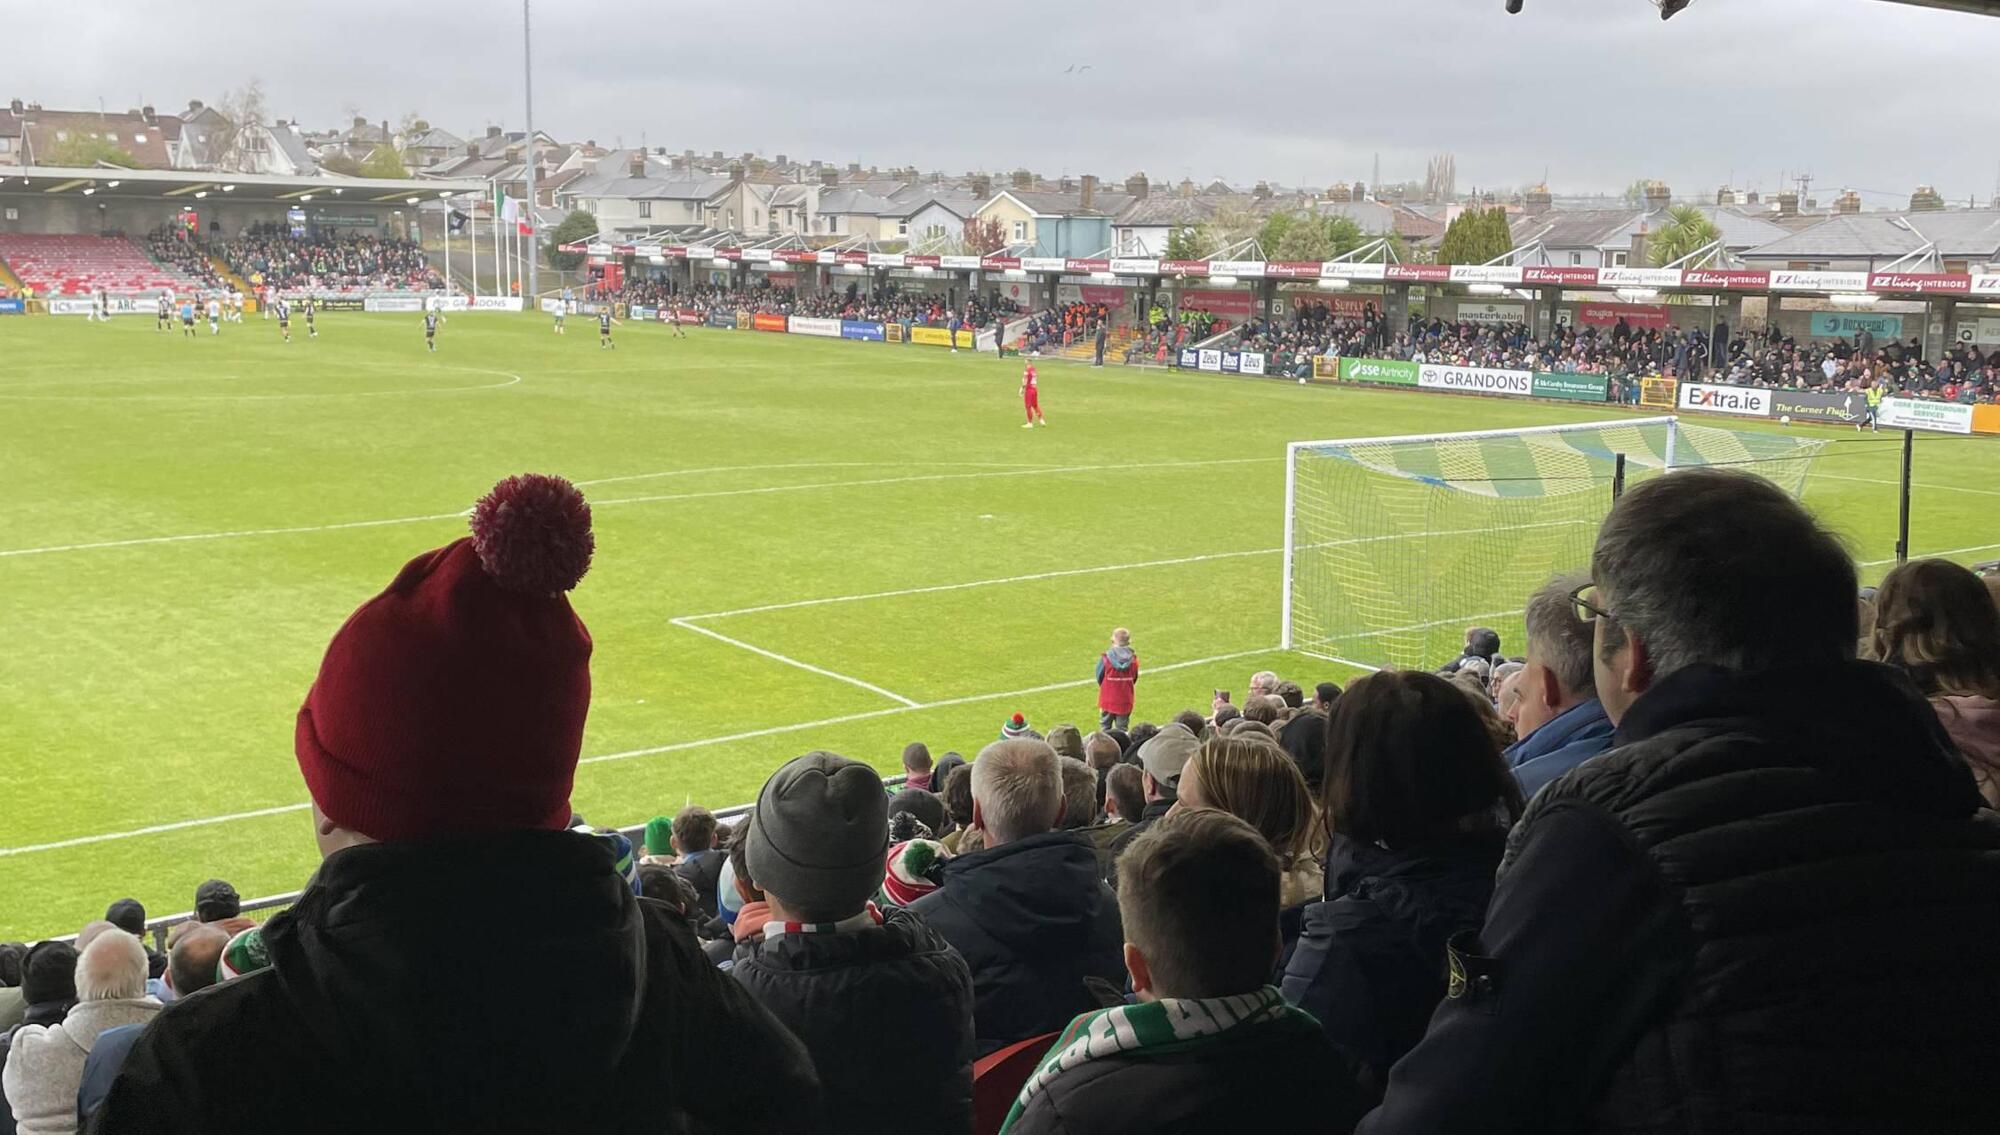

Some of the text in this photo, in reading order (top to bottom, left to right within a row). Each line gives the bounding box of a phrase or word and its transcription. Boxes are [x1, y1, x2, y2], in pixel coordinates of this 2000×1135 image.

[1267, 264, 1278, 272] EZ
[1326, 266, 1336, 274] EZ
[1388, 267, 1400, 276] EZ
[1400, 266, 1420, 280] living
[1454, 268, 1467, 277] EZ
[1526, 270, 1540, 279] EZ
[1540, 269, 1563, 283] living
[1604, 272, 1617, 280] EZ
[1618, 272, 1642, 284] living
[1685, 273, 1701, 282] EZ
[1702, 272, 1729, 288] living
[1776, 274, 1862, 289] EZ living INTERIORS
[1872, 276, 1967, 292] EZ living INTERIORS
[1978, 279, 1999, 288] EZ
[1459, 311, 1523, 320] masterkabin
[1560, 316, 1568, 324] P
[1842, 318, 1886, 332] ROCKSHORE
[1962, 330, 1972, 341] Q
[1181, 350, 1196, 363] Zeus
[1202, 351, 1218, 364] Zeus
[1222, 352, 1238, 366] Zeus
[1244, 354, 1260, 368] Zeus
[1362, 364, 1414, 381] sse Airtricity
[1444, 371, 1528, 391] GRANDONS
[1689, 387, 1760, 410] Extra.ie
[1776, 403, 1792, 412] The
[1794, 406, 1824, 415] Corner
